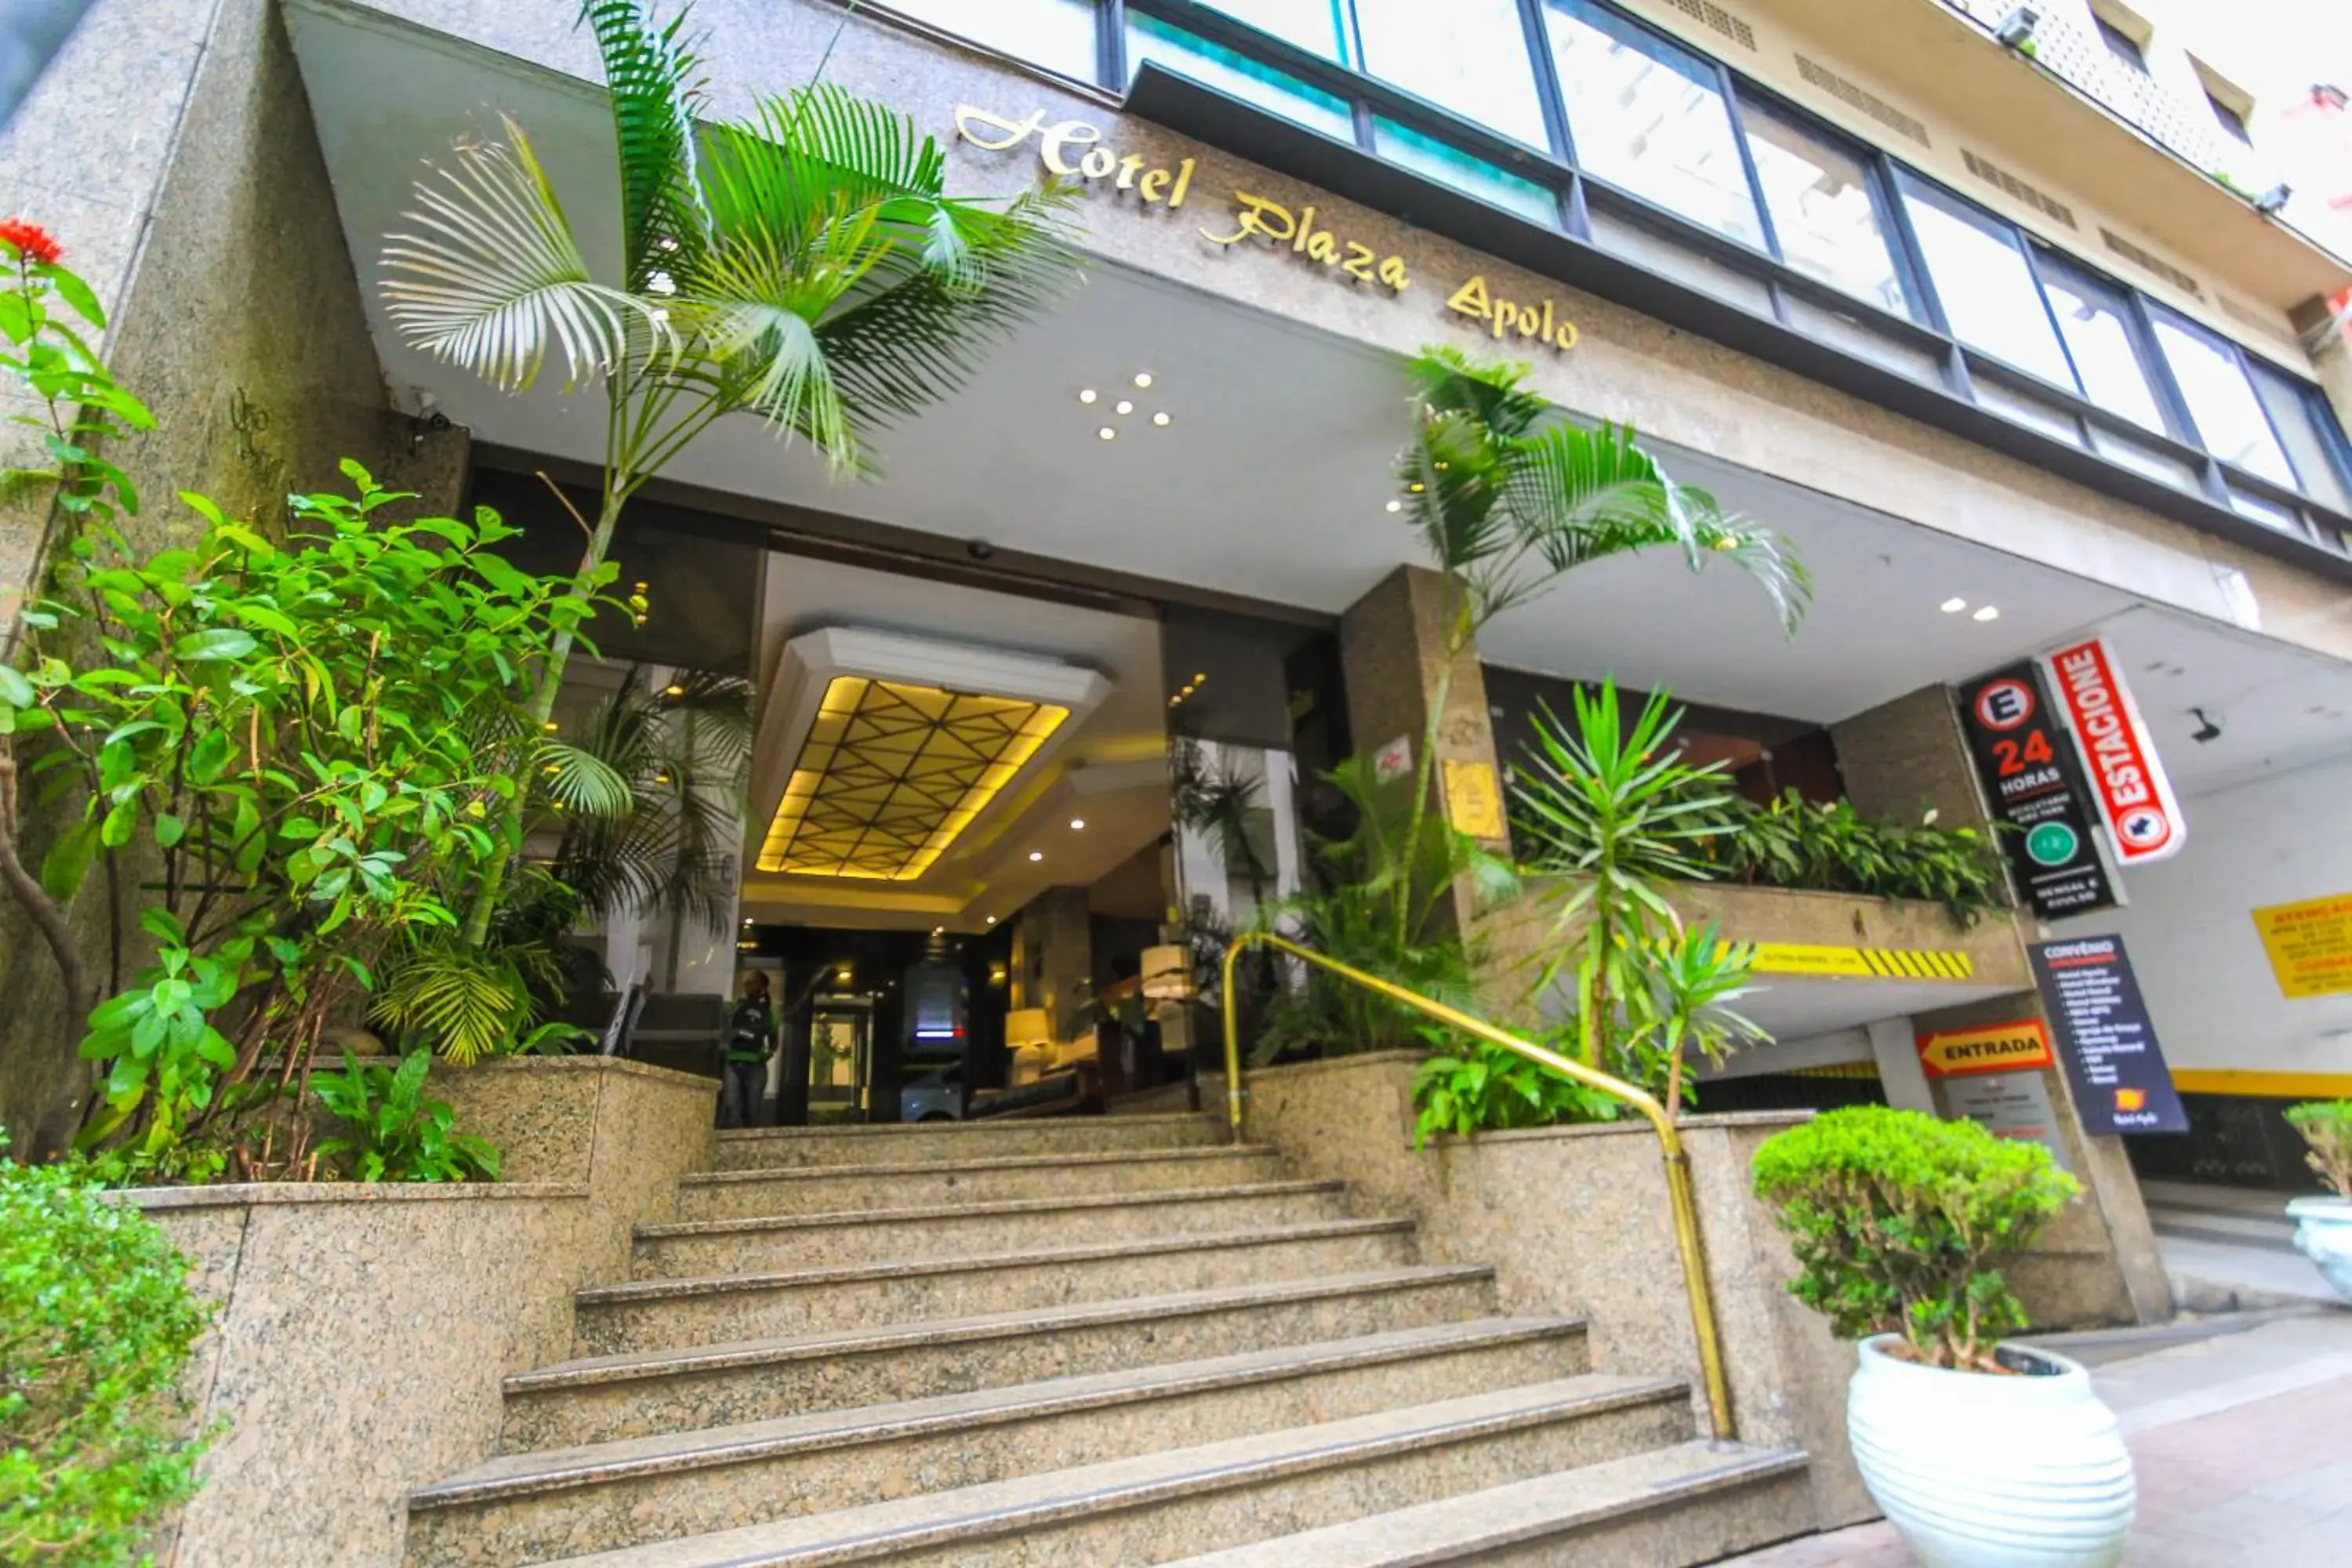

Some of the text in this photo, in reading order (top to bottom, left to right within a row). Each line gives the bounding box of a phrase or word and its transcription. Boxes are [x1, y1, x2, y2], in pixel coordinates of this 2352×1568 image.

[953, 105, 1580, 350] Hotel Plaza Apolo
[1988, 688, 2020, 722] E
[2063, 648, 2148, 806] ESTACIONE
[1993, 730, 2053, 776] 24
[2001, 768, 2060, 796] HORAS
[1945, 1037, 2041, 1060] ENTRADA
